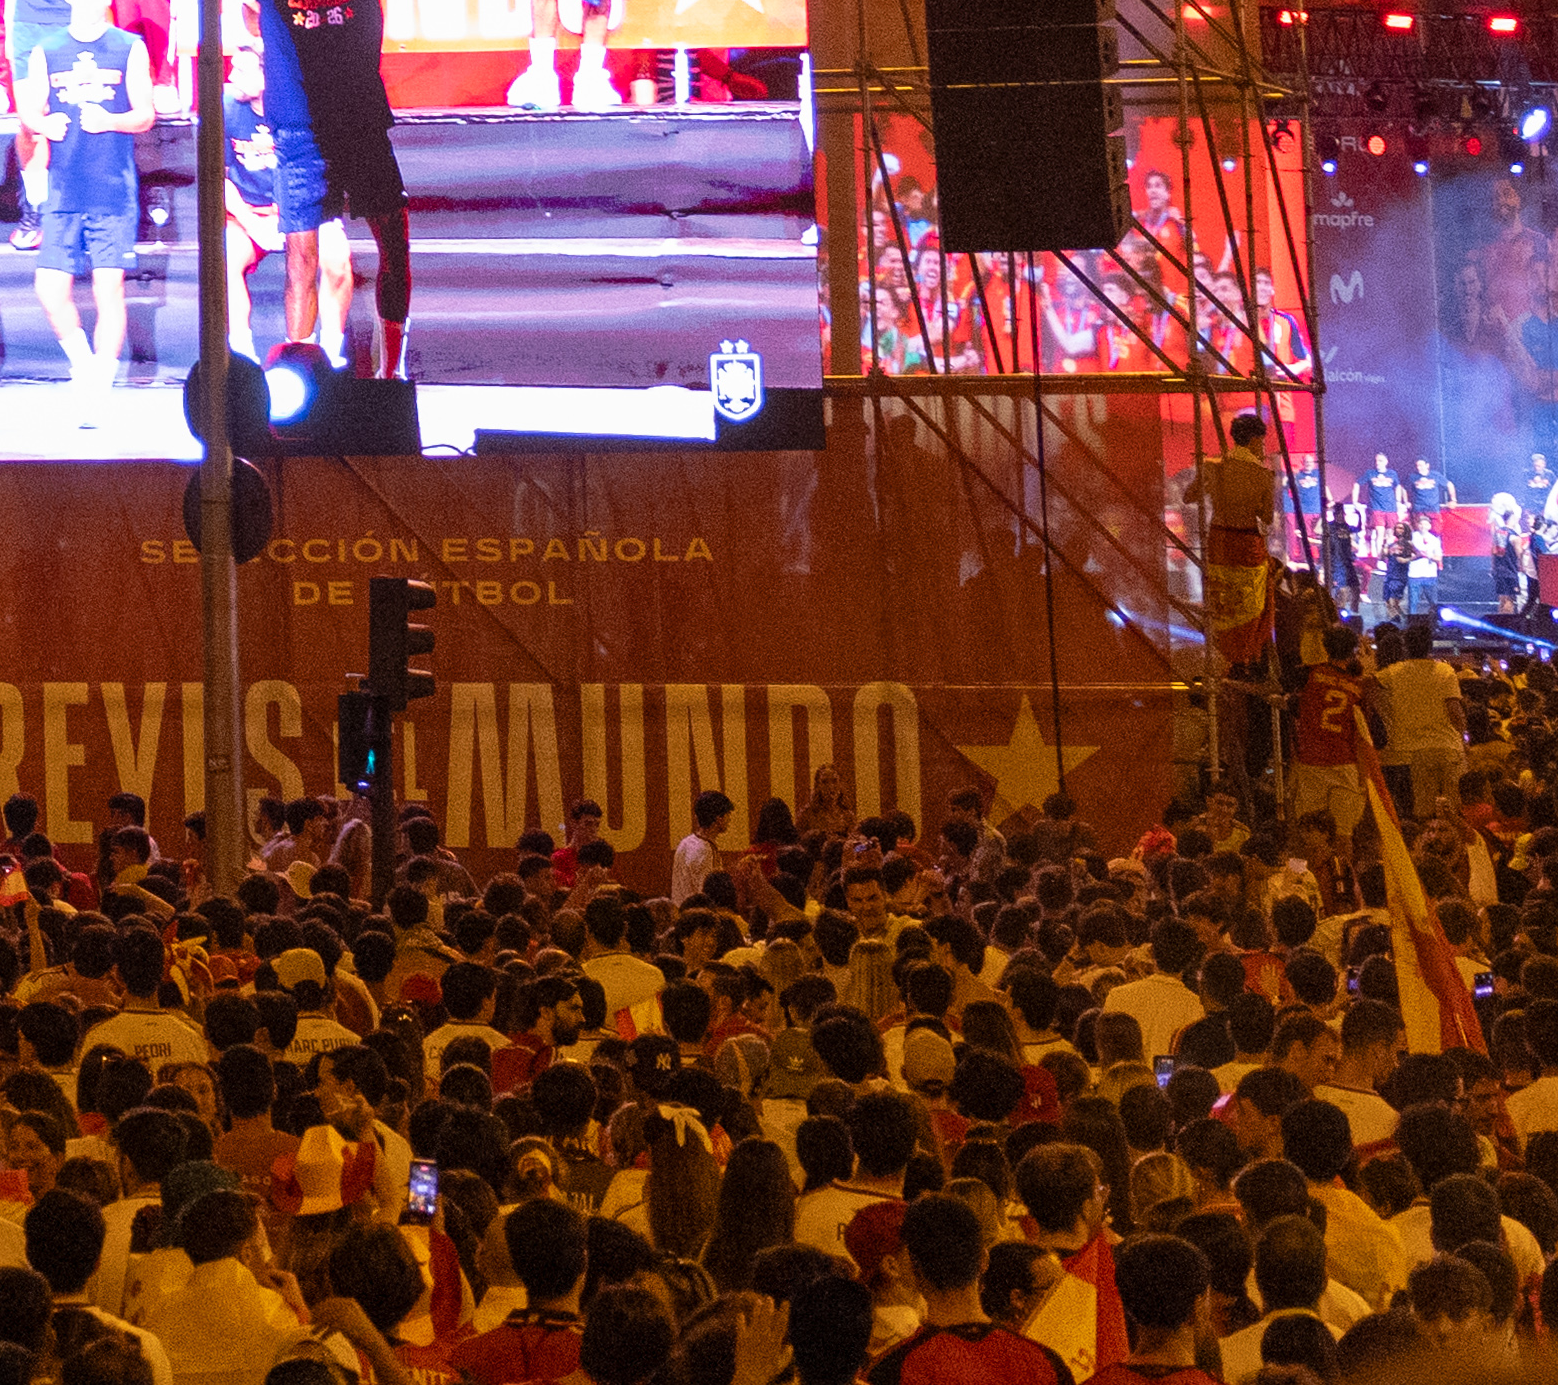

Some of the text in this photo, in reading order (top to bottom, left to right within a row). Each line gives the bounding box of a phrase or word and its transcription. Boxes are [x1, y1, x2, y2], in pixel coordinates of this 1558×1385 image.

[1313, 211, 1374, 229] mapfre
[140, 531, 714, 563] SECCIÓN ESPAÑOLA
[293, 580, 354, 606] DE
[445, 681, 921, 852] MUNDO
